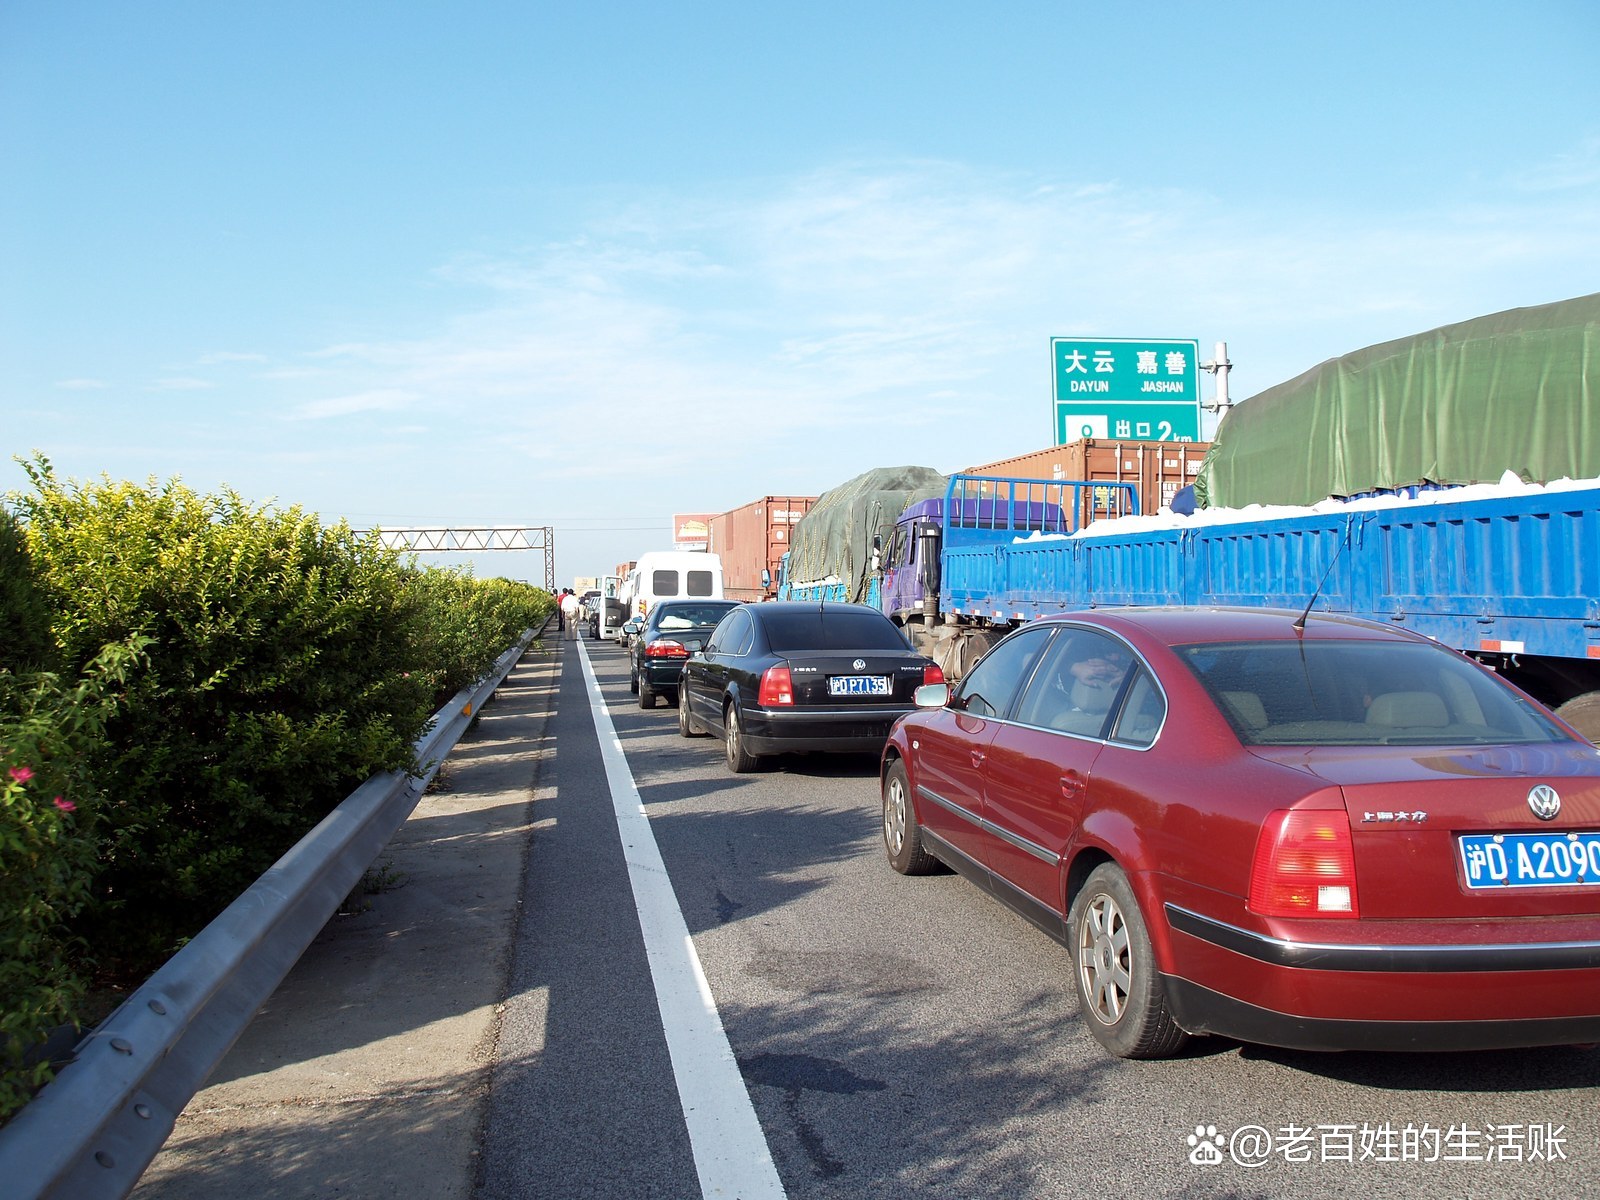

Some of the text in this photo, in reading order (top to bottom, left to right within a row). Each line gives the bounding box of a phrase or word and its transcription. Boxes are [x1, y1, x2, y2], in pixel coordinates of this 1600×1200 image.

[1065, 350, 1187, 375] 大云 嘉善
[1070, 381, 1184, 393] DAYUN JIASHAN
[1115, 420, 1150, 438] 出口
